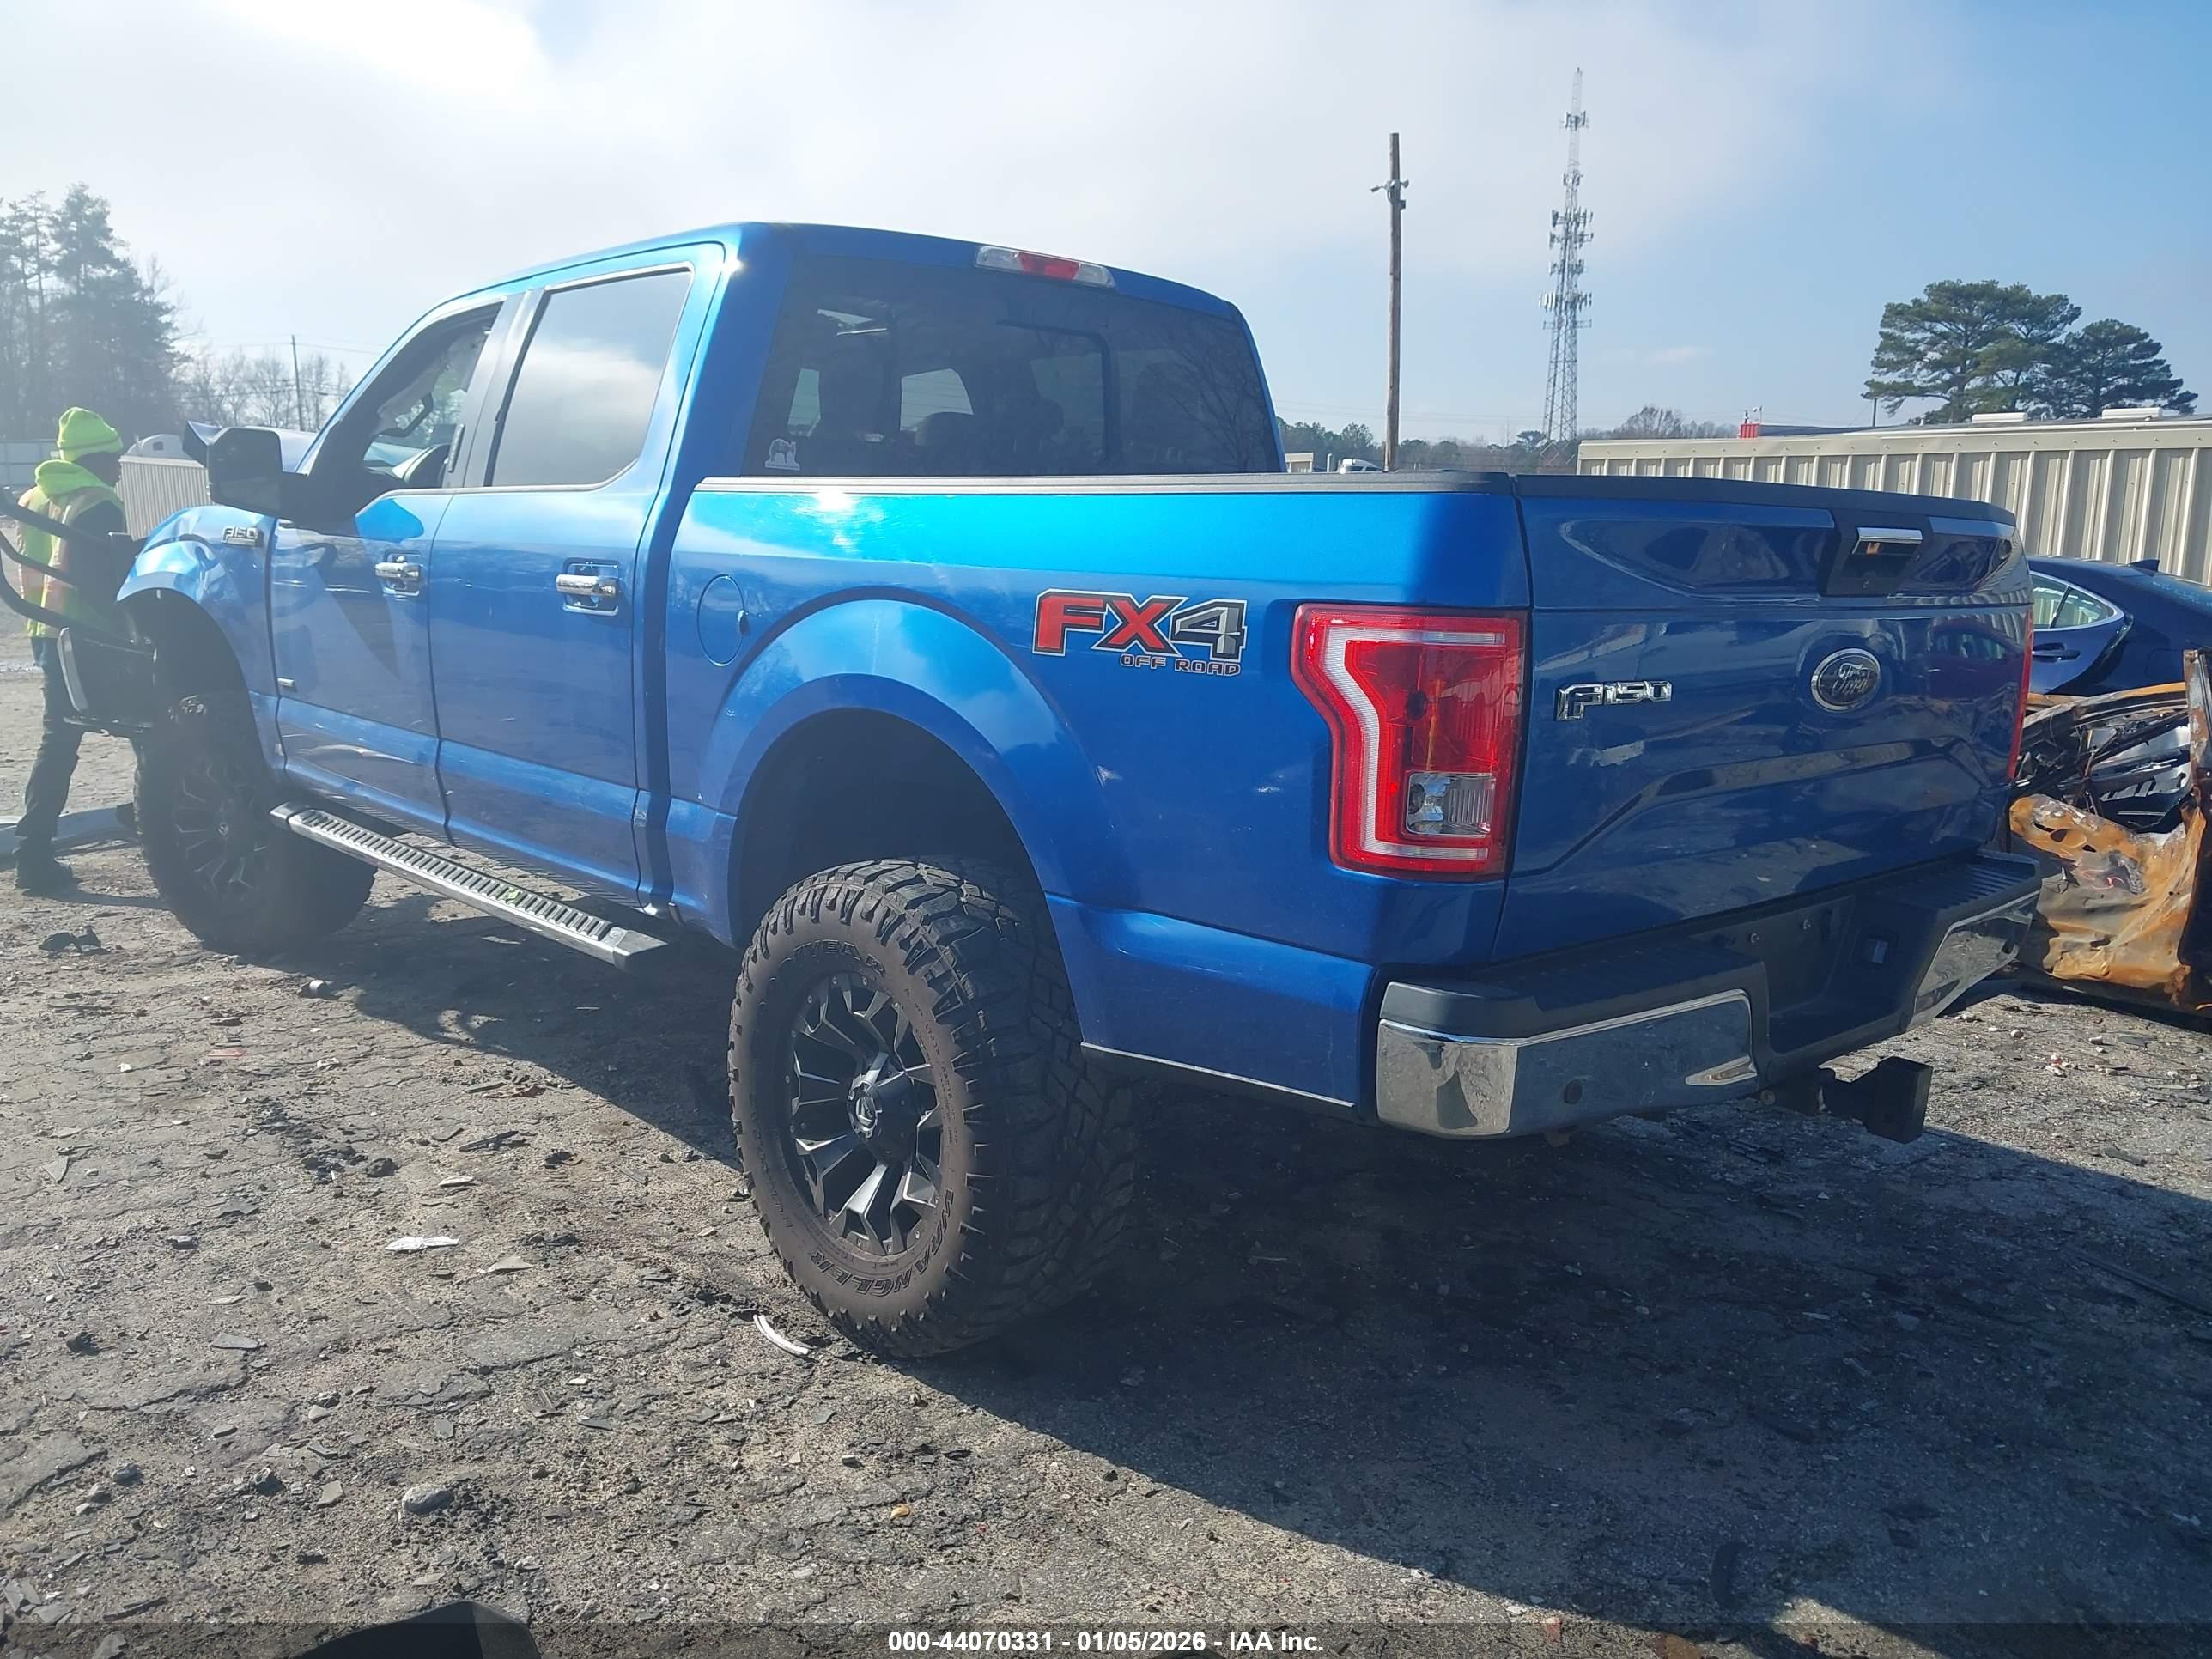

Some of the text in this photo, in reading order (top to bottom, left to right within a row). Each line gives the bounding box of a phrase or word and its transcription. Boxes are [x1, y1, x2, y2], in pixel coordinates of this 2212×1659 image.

[221, 526, 258, 544] F150
[1032, 588, 1248, 663] FX4
[1120, 654, 1241, 677] OFF ROAD
[1555, 680, 1674, 722] F150
[810, 1188, 955, 1297] WRANGLER
